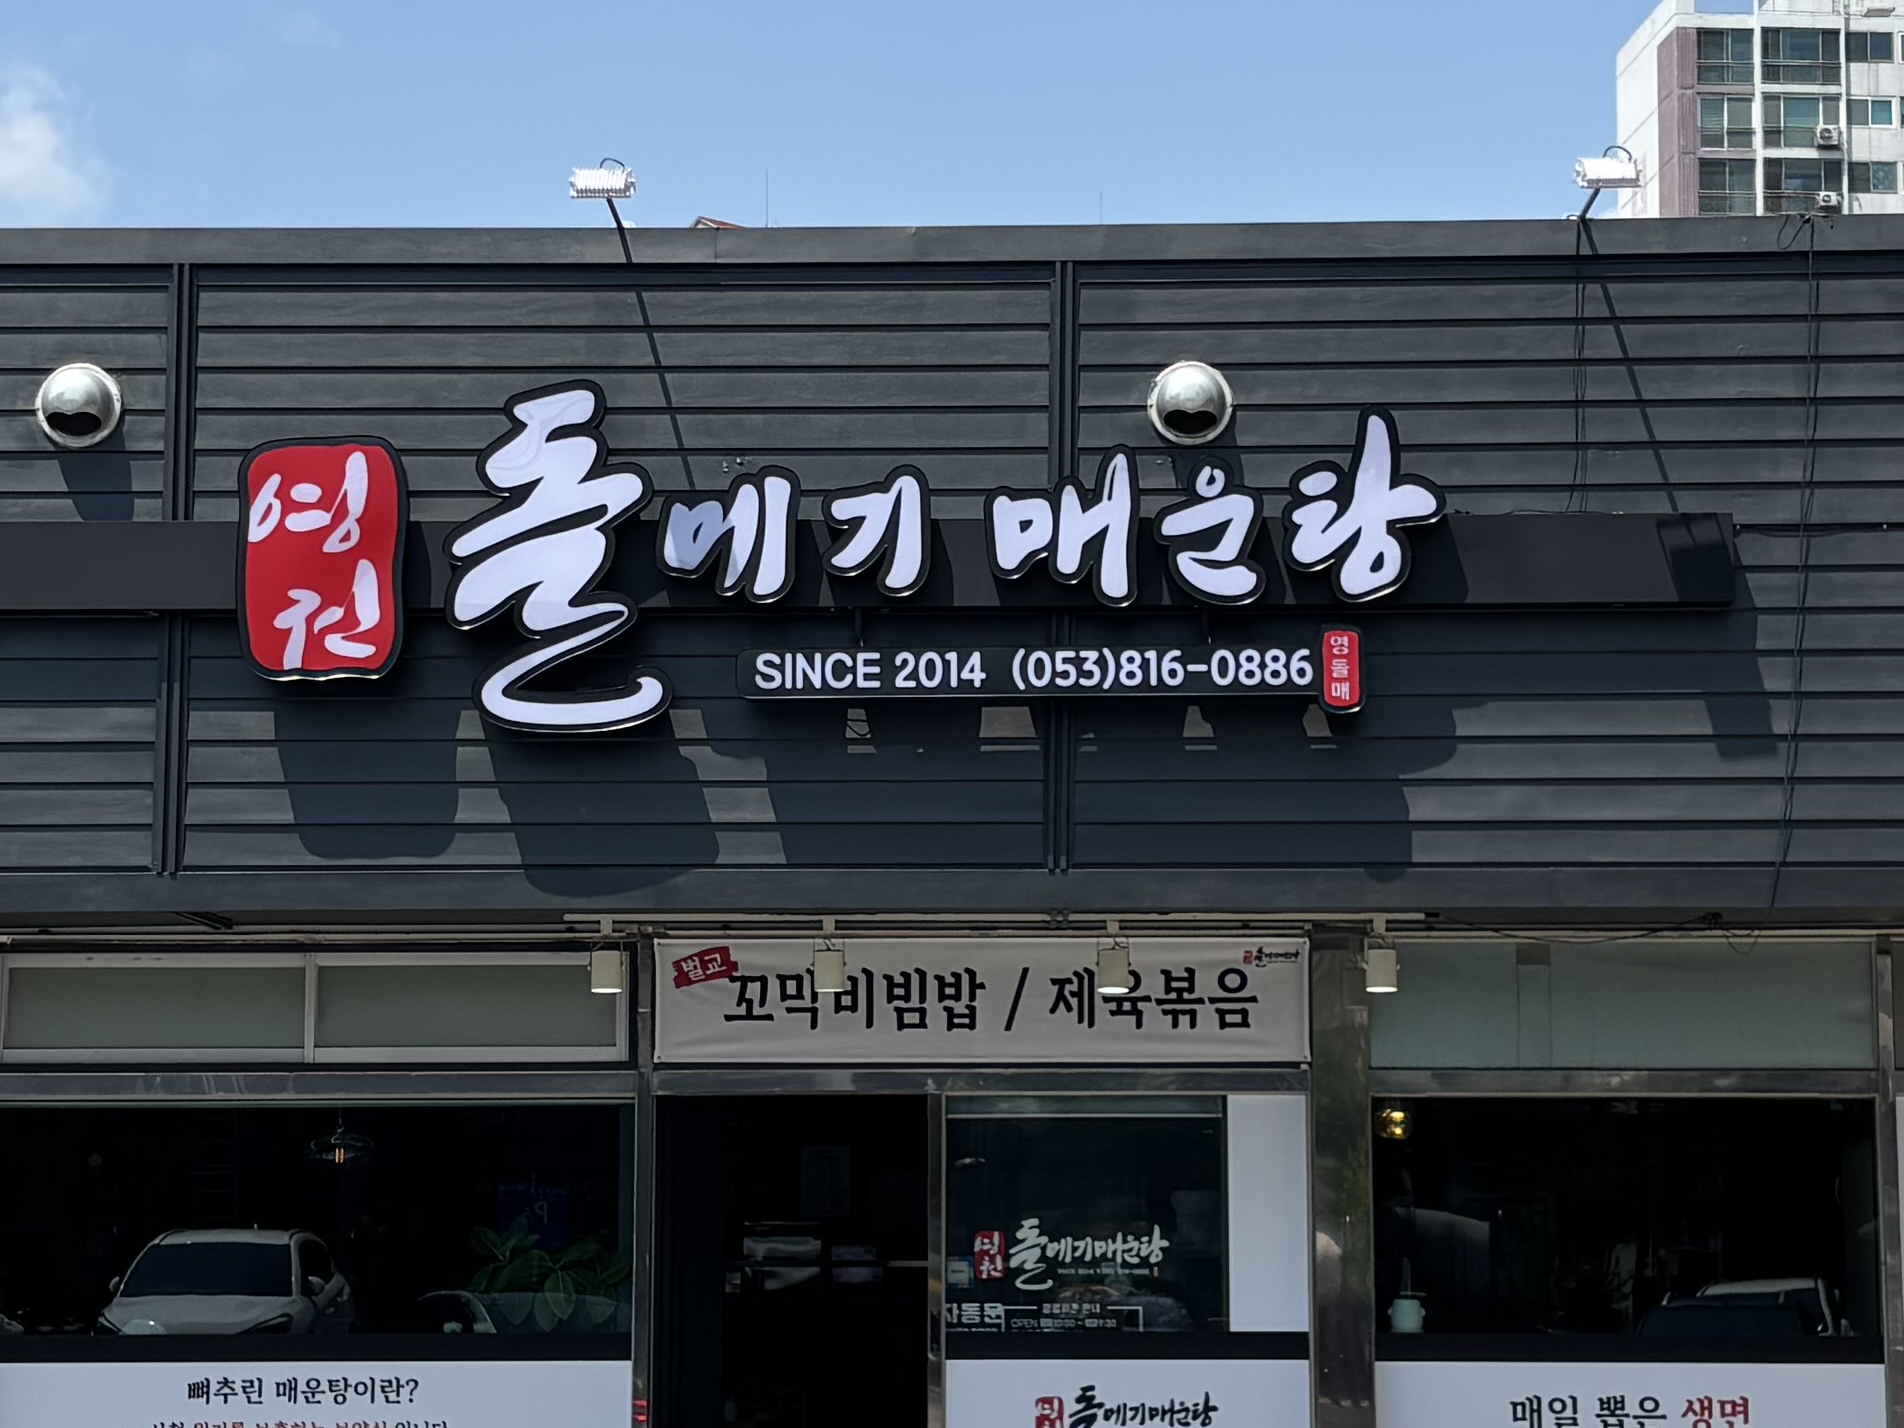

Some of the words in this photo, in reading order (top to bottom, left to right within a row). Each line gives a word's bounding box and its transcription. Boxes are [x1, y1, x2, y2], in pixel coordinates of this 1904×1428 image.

[247, 450, 382, 670] 영천
[448, 387, 926, 727] 돌메기
[992, 410, 1443, 603] 매운탕
[754, 652, 881, 690] SINCE
[894, 651, 986, 690] 2014
[1011, 647, 1314, 691] (053)816-0886
[682, 953, 728, 981] 벌교
[723, 967, 987, 1032] 꼬막비빔밥
[1049, 966, 1259, 1031] 제육볶음
[187, 1376, 263, 1405] 뼈추린
[275, 1376, 419, 1405] 매운탕이란?
